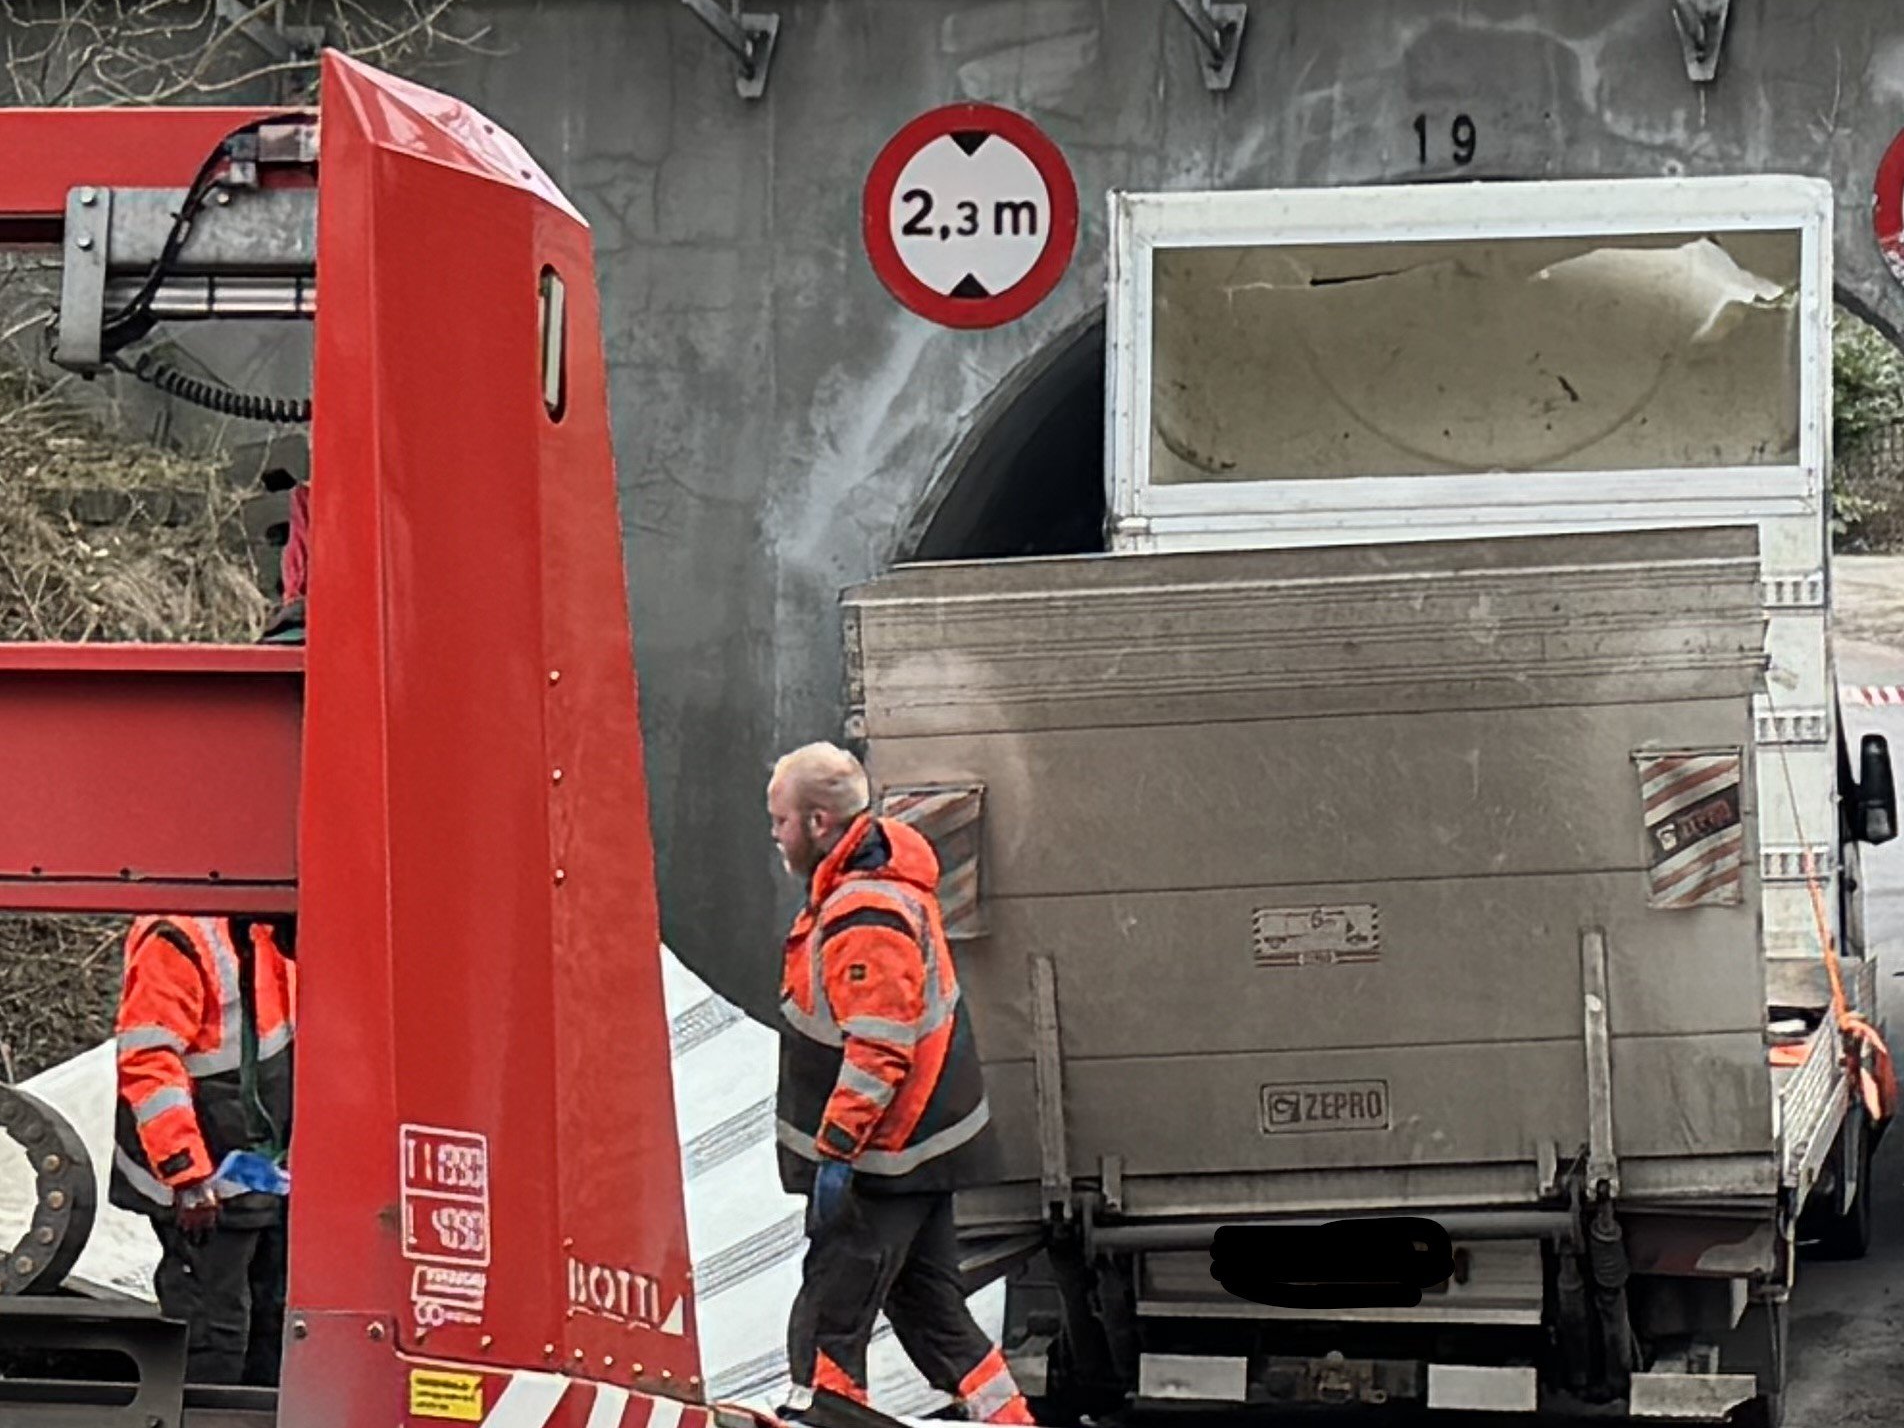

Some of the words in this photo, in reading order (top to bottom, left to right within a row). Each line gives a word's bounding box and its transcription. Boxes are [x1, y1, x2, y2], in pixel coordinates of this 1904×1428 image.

[1412, 113, 1477, 168] 19
[901, 188, 980, 242] 2,3
[993, 200, 1038, 236] m
[1303, 1090, 1383, 1122] ZEPRO
